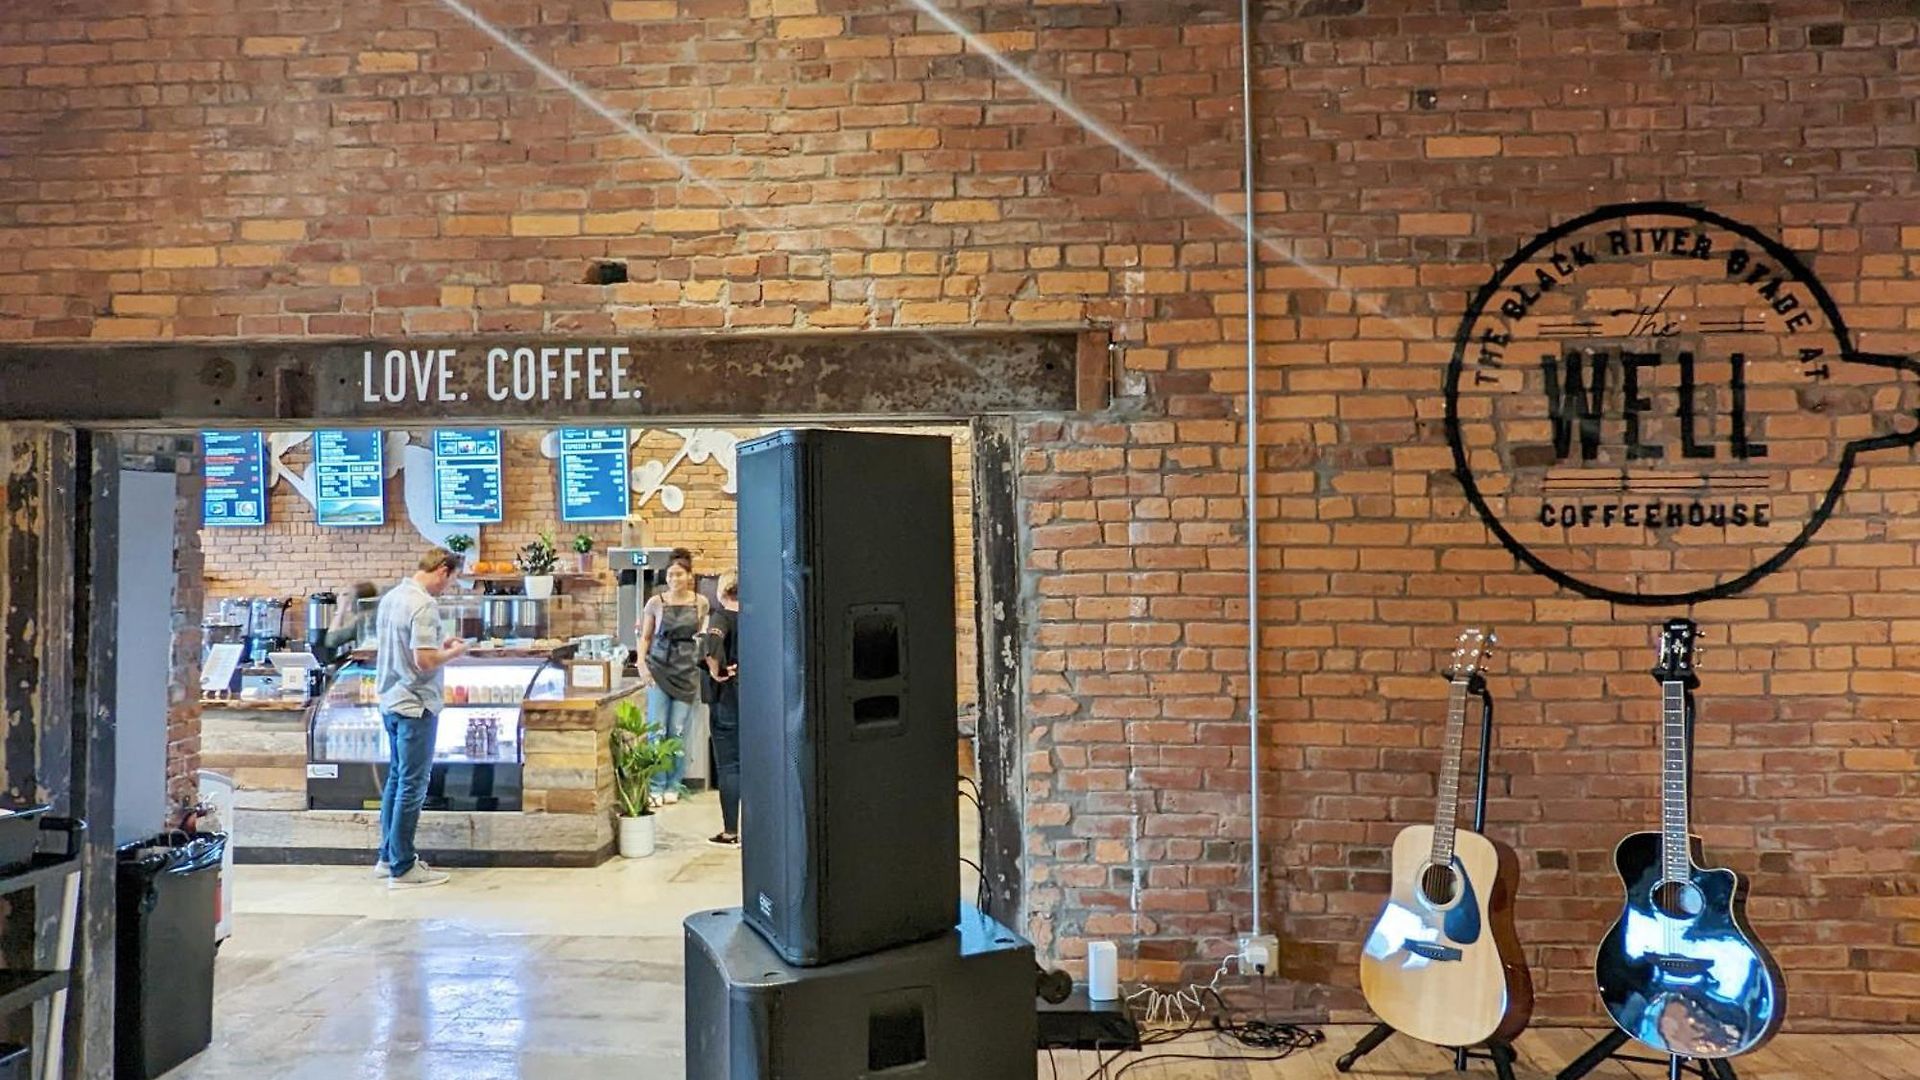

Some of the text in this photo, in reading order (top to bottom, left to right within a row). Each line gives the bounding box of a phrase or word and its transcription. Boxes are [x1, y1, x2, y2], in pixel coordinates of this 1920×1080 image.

[1475, 328, 1511, 386] THE
[1501, 242, 1595, 321] BLACK
[1606, 228, 1712, 260] RIVER
[1798, 348, 1830, 380] AT
[1611, 284, 1681, 338] the
[364, 347, 642, 402] LOVE. COFFEE.
[1541, 352, 1768, 460] WELL
[1540, 503, 1770, 528] COFFEEHOUSE
